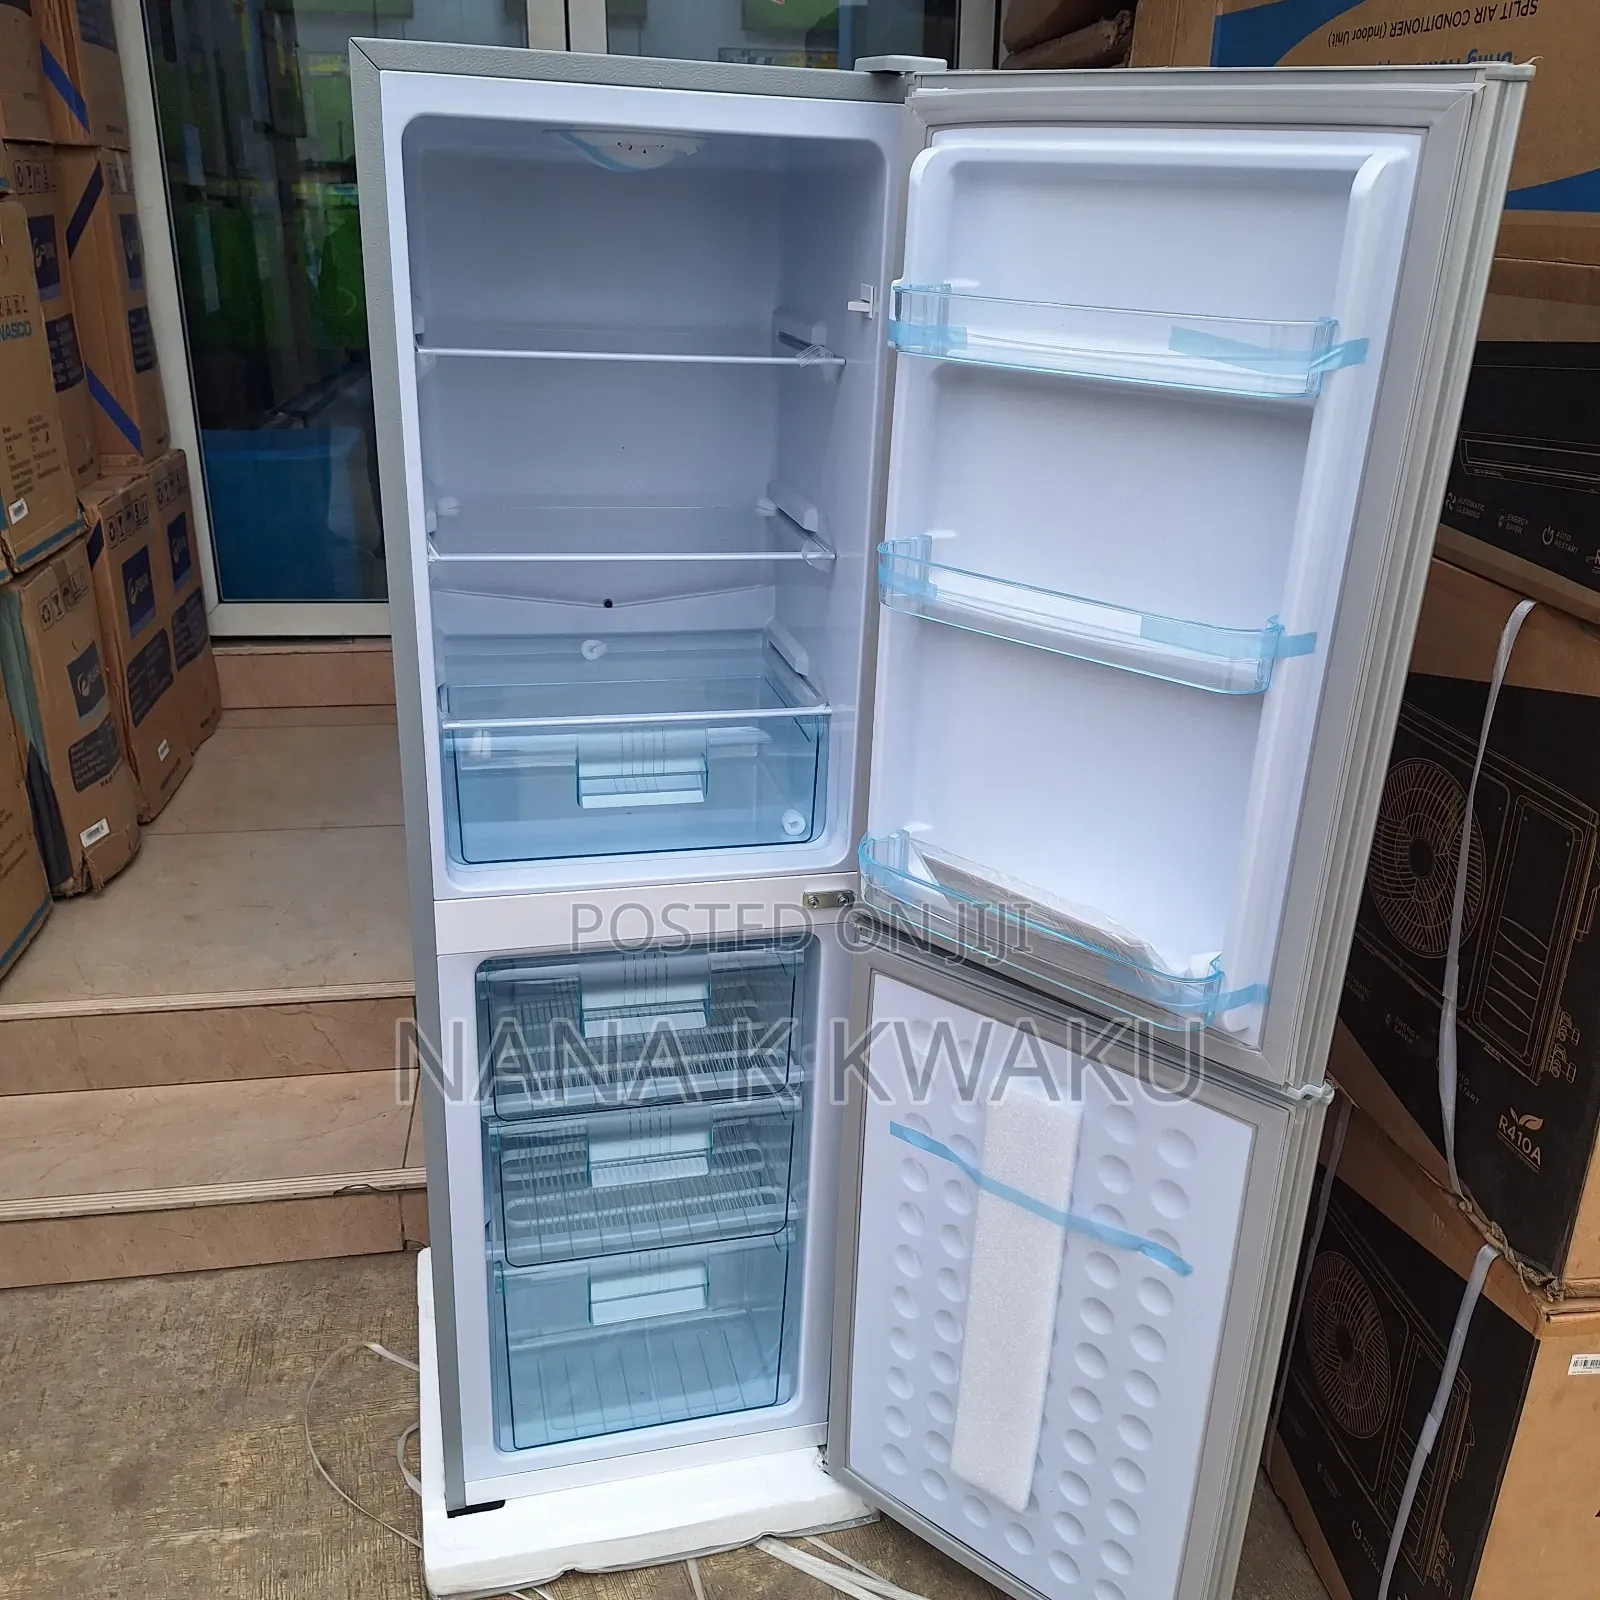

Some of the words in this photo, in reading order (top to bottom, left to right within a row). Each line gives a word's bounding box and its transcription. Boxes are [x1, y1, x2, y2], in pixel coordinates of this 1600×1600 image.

[1474, 4, 1498, 24] AIR
[1499, 0, 1538, 20] SPLIT
[1352, 21, 1387, 42] (Indoor
[1389, 9, 1470, 38] CONDITIONER
[1328, 30, 1350, 47] Unit)
[1456, 505, 1481, 519] CLEANING
[1457, 497, 1485, 512] AUTOMATIC
[1507, 513, 1529, 526] ENERGY
[1556, 531, 1572, 542] AUTO
[1554, 540, 1579, 555] RESTART
[1498, 1114, 1541, 1166] R410A
